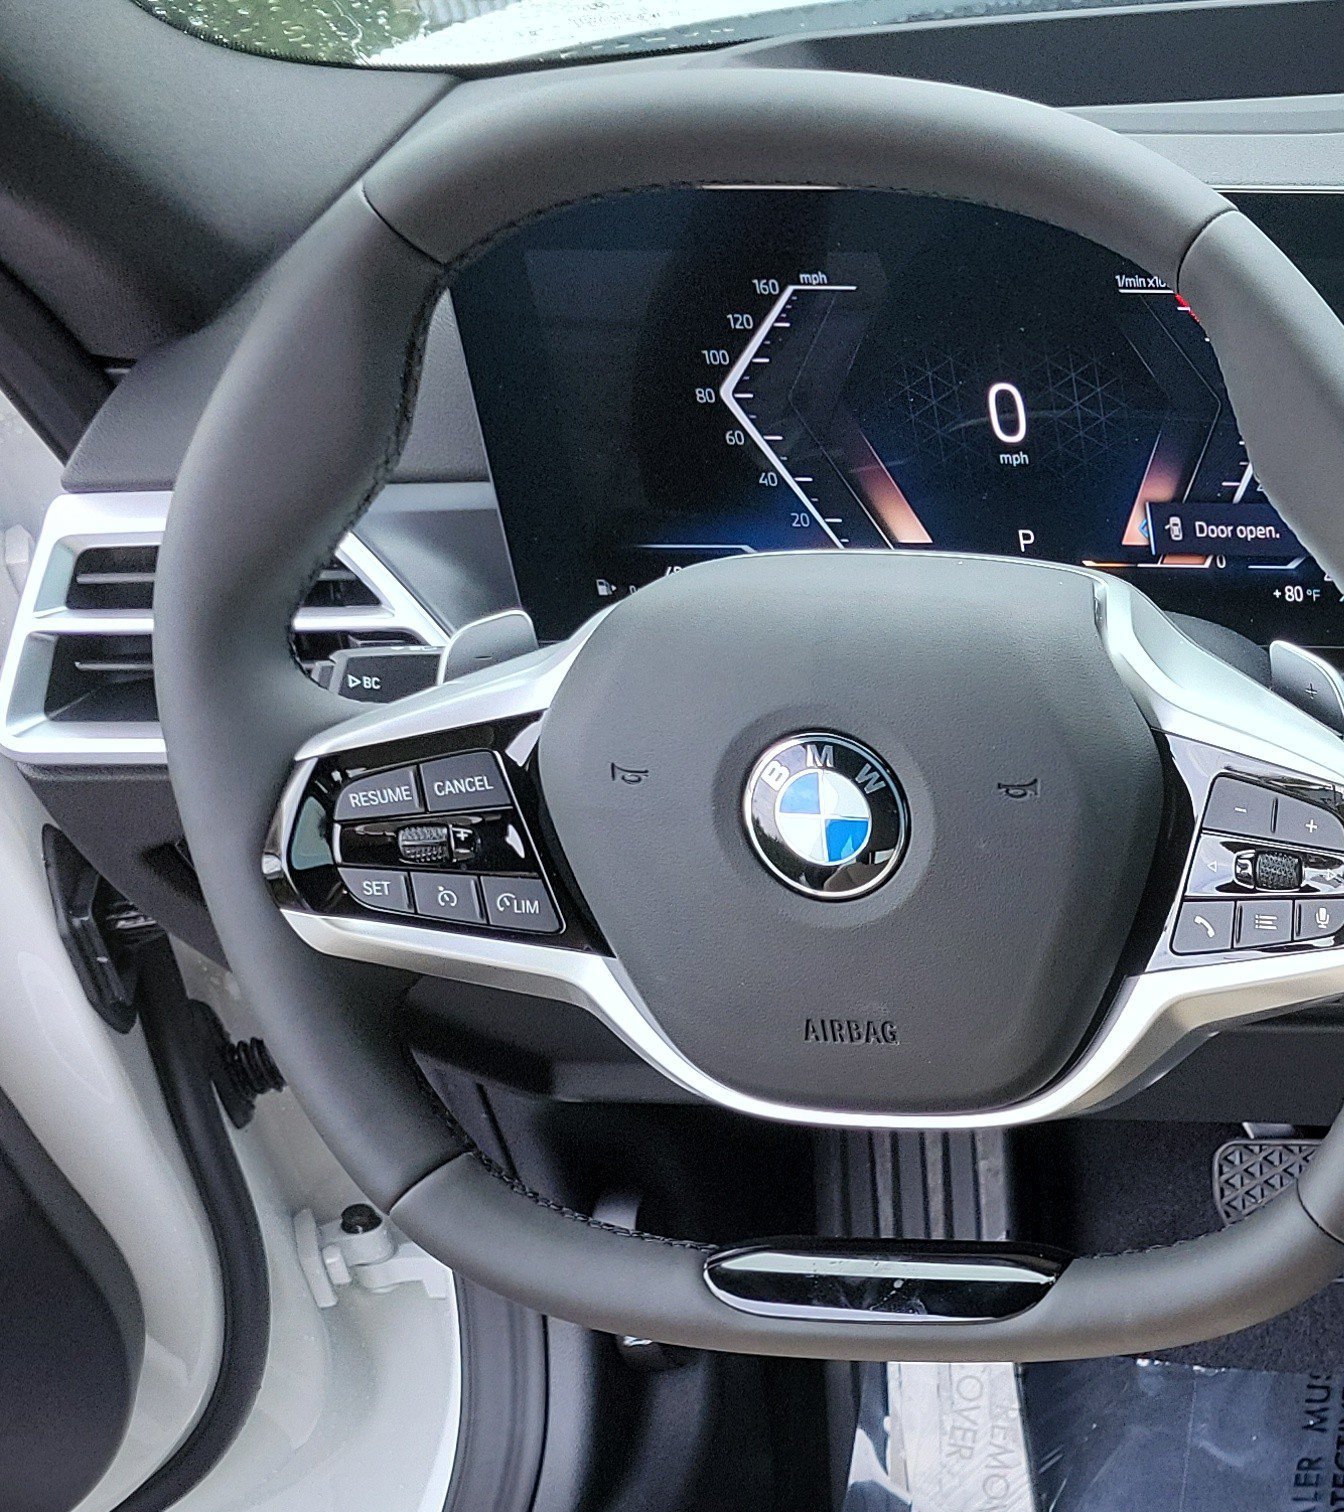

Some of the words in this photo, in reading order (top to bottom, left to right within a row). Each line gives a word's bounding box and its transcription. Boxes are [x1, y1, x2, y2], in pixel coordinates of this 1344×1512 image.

[799, 271, 828, 285] mph
[752, 279, 779, 295] 160
[727, 314, 754, 330] 120
[702, 350, 730, 366] 100
[695, 388, 716, 404] 80
[988, 382, 1027, 443] 0
[725, 430, 744, 446] 60
[1000, 451, 1030, 467] mph
[758, 472, 778, 487] 40
[790, 512, 810, 528] 20
[1195, 521, 1233, 539] Door
[1236, 524, 1280, 541] open.
[1018, 529, 1035, 552] P
[1216, 554, 1227, 569] 0
[362, 676, 382, 690] BC
[760, 744, 887, 794] BMW
[434, 776, 494, 797] CANCEL
[350, 786, 414, 808] RESUME
[362, 880, 391, 896] SET
[514, 899, 540, 914] LIM
[804, 1018, 899, 1044] AIRBAG
